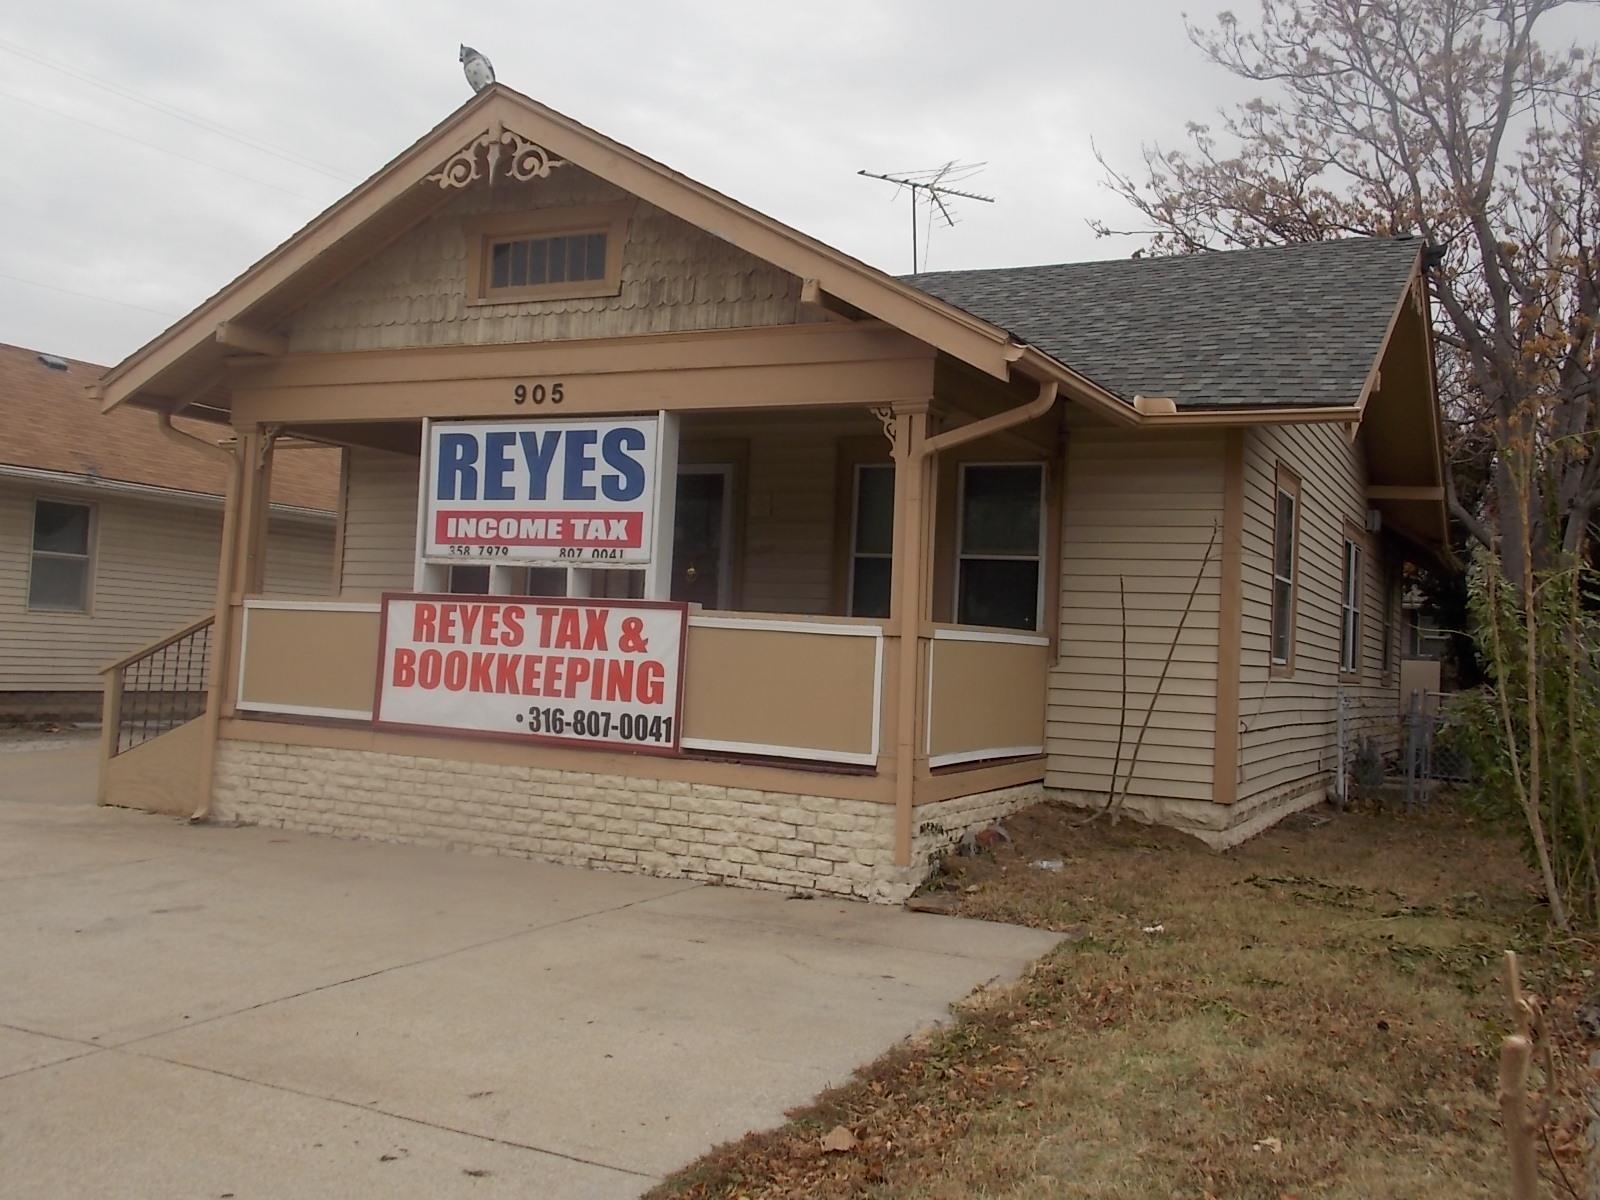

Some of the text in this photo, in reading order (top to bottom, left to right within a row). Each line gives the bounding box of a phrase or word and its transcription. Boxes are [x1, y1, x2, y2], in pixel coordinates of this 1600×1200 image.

[514, 383, 564, 405] 905
[437, 427, 646, 502] REYES
[446, 517, 629, 541] INCOME TAX
[412, 603, 648, 653] REYES TAX &
[392, 648, 665, 705] BOOKKEEPING
[528, 706, 672, 743] 316-807-0041
